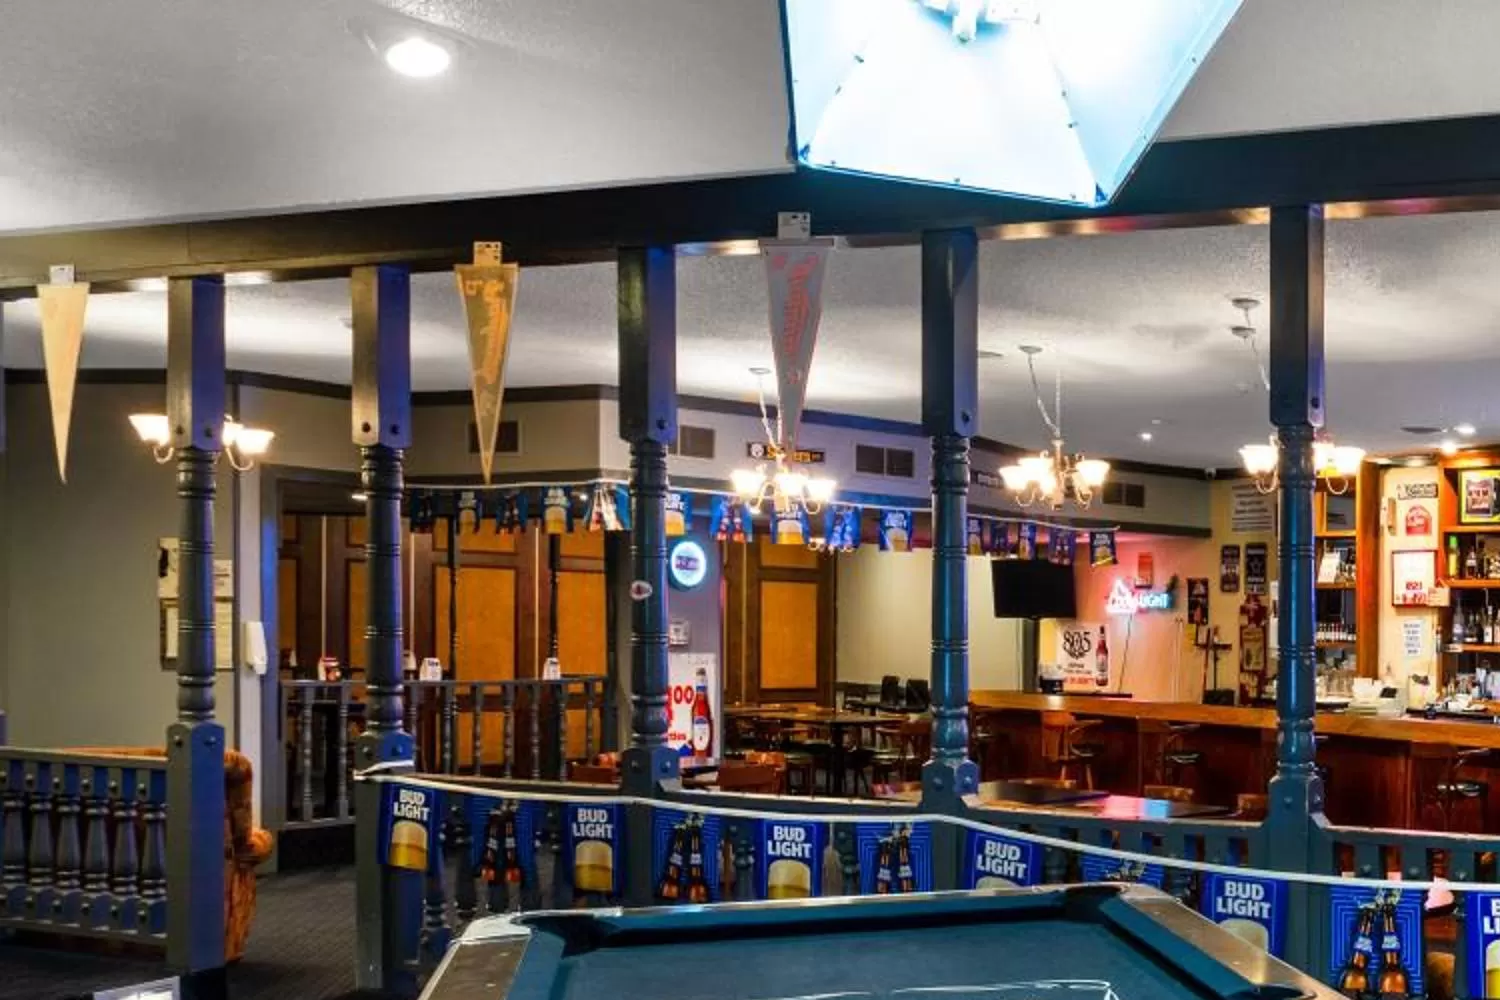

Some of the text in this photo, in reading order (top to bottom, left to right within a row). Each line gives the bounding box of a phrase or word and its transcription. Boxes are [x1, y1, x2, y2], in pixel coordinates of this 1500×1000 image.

[399, 789, 425, 805] BUD
[393, 801, 430, 821] LIGHT
[577, 807, 608, 823] BUD
[571, 821, 614, 839] LIGHT
[773, 825, 806, 842] BUD
[767, 840, 813, 859] LIGHT
[985, 839, 1021, 861] BUD
[976, 854, 1027, 879] LIGHT
[1224, 880, 1265, 900] BUD
[1215, 895, 1272, 919] LIGHT
